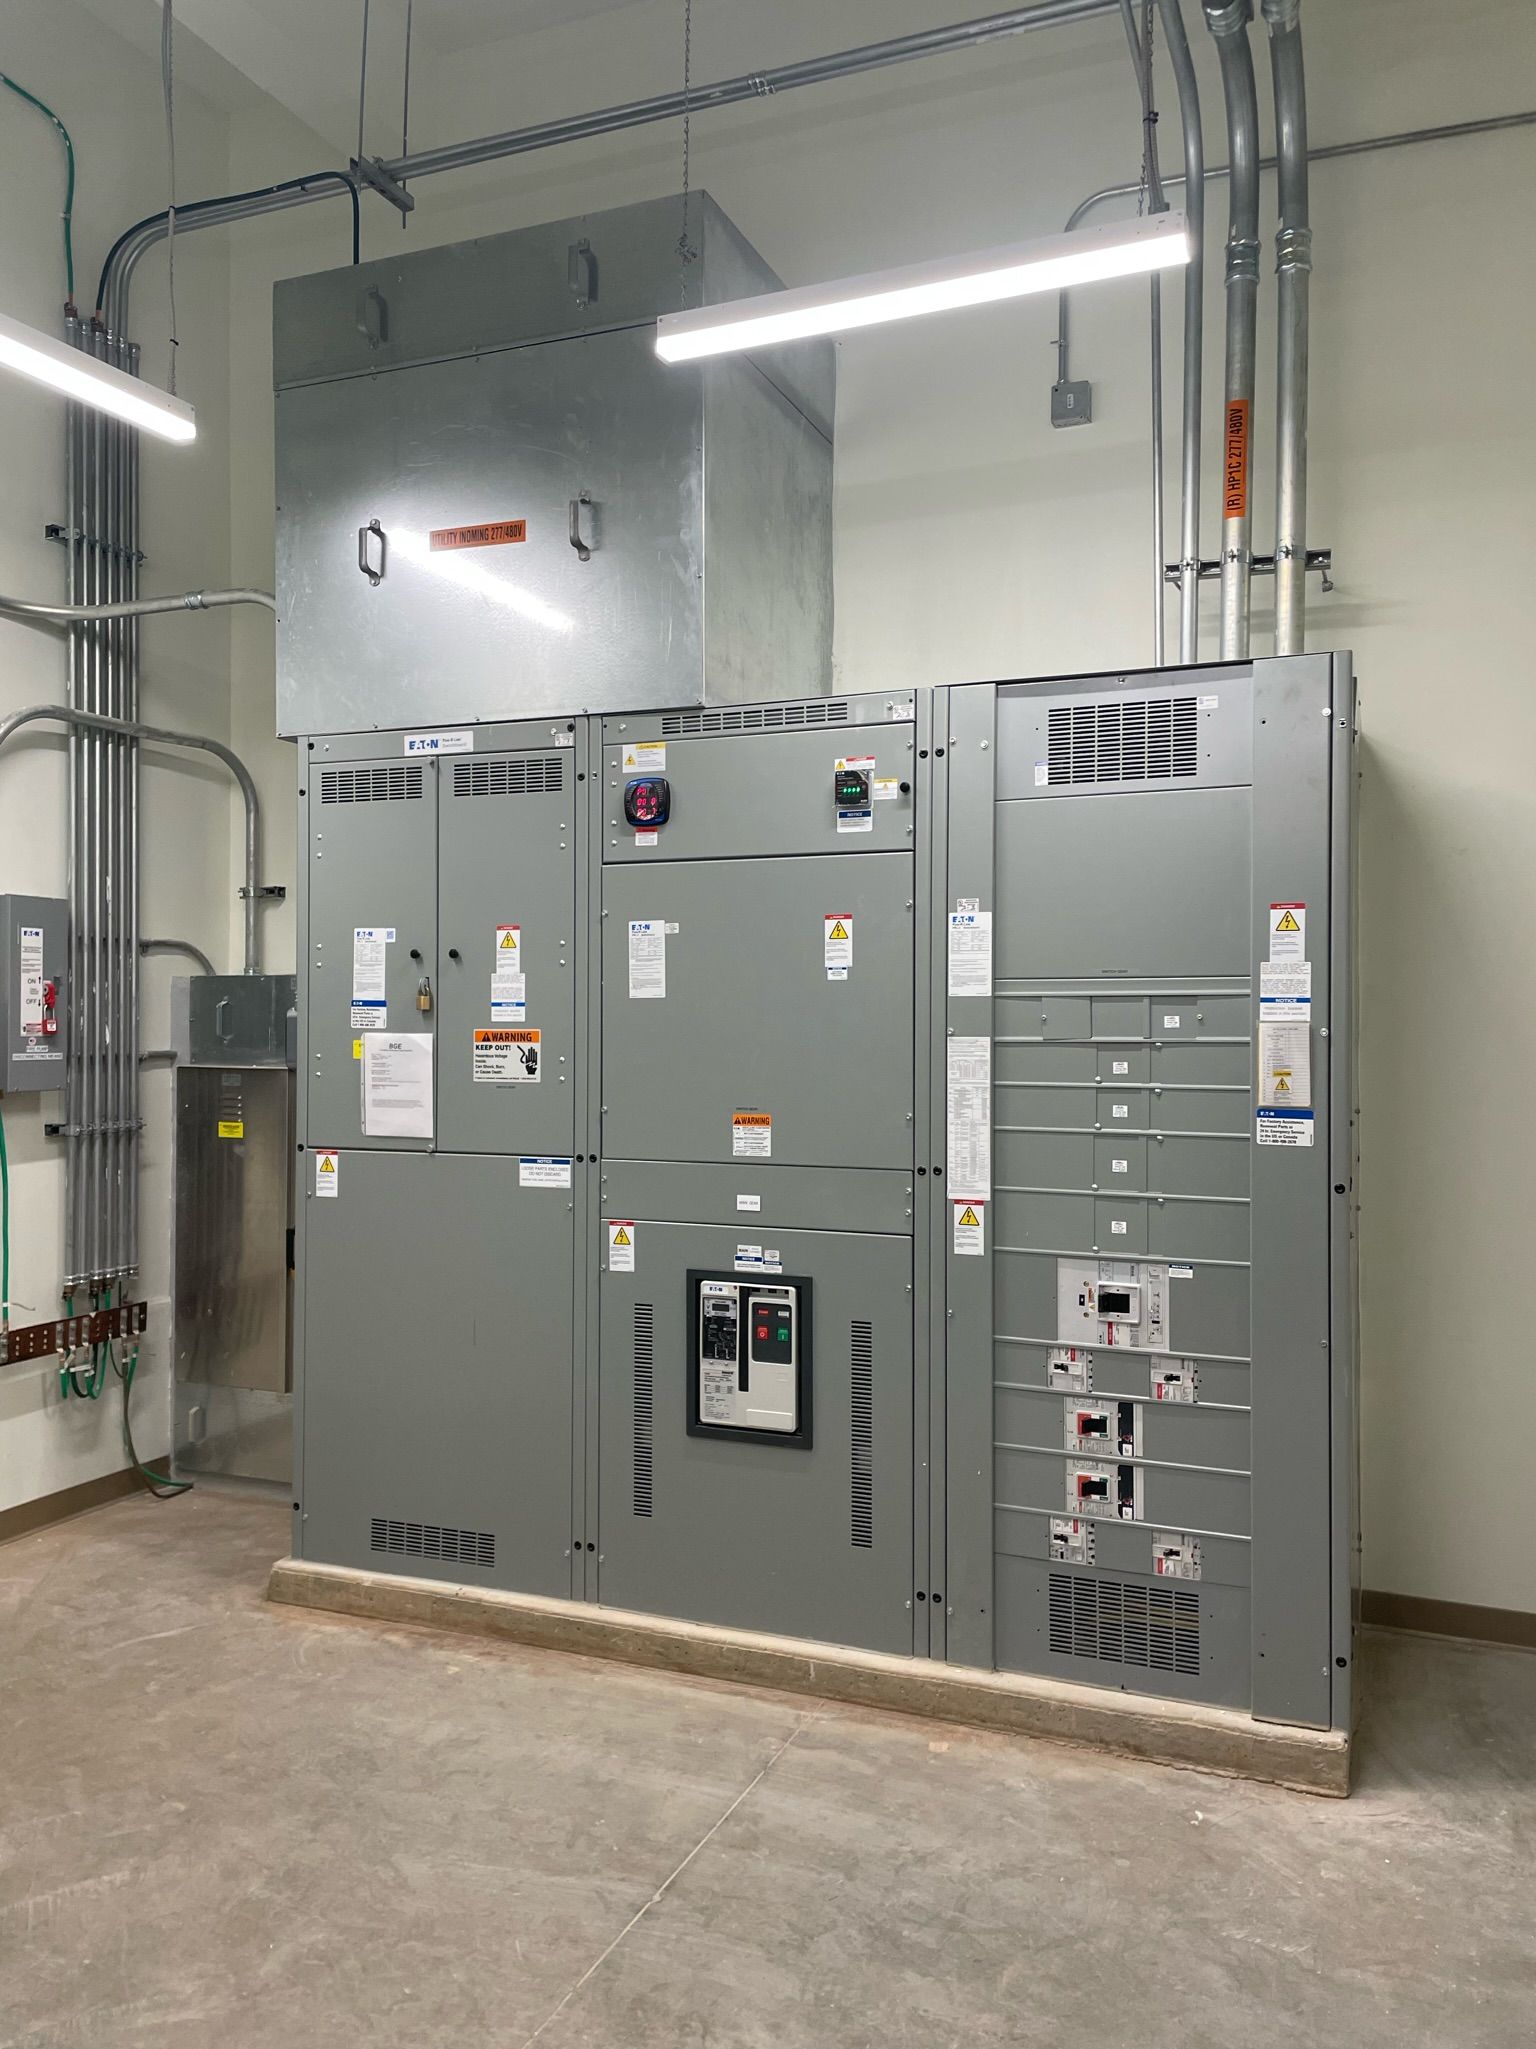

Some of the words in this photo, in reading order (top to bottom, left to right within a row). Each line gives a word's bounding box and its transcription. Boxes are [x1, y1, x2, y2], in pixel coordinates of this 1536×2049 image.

[1228, 408, 1243, 460] 277/480V
[490, 523, 523, 540] 277/480V
[491, 1033, 533, 1042] WARNING
[741, 1116, 770, 1126] WARNING
